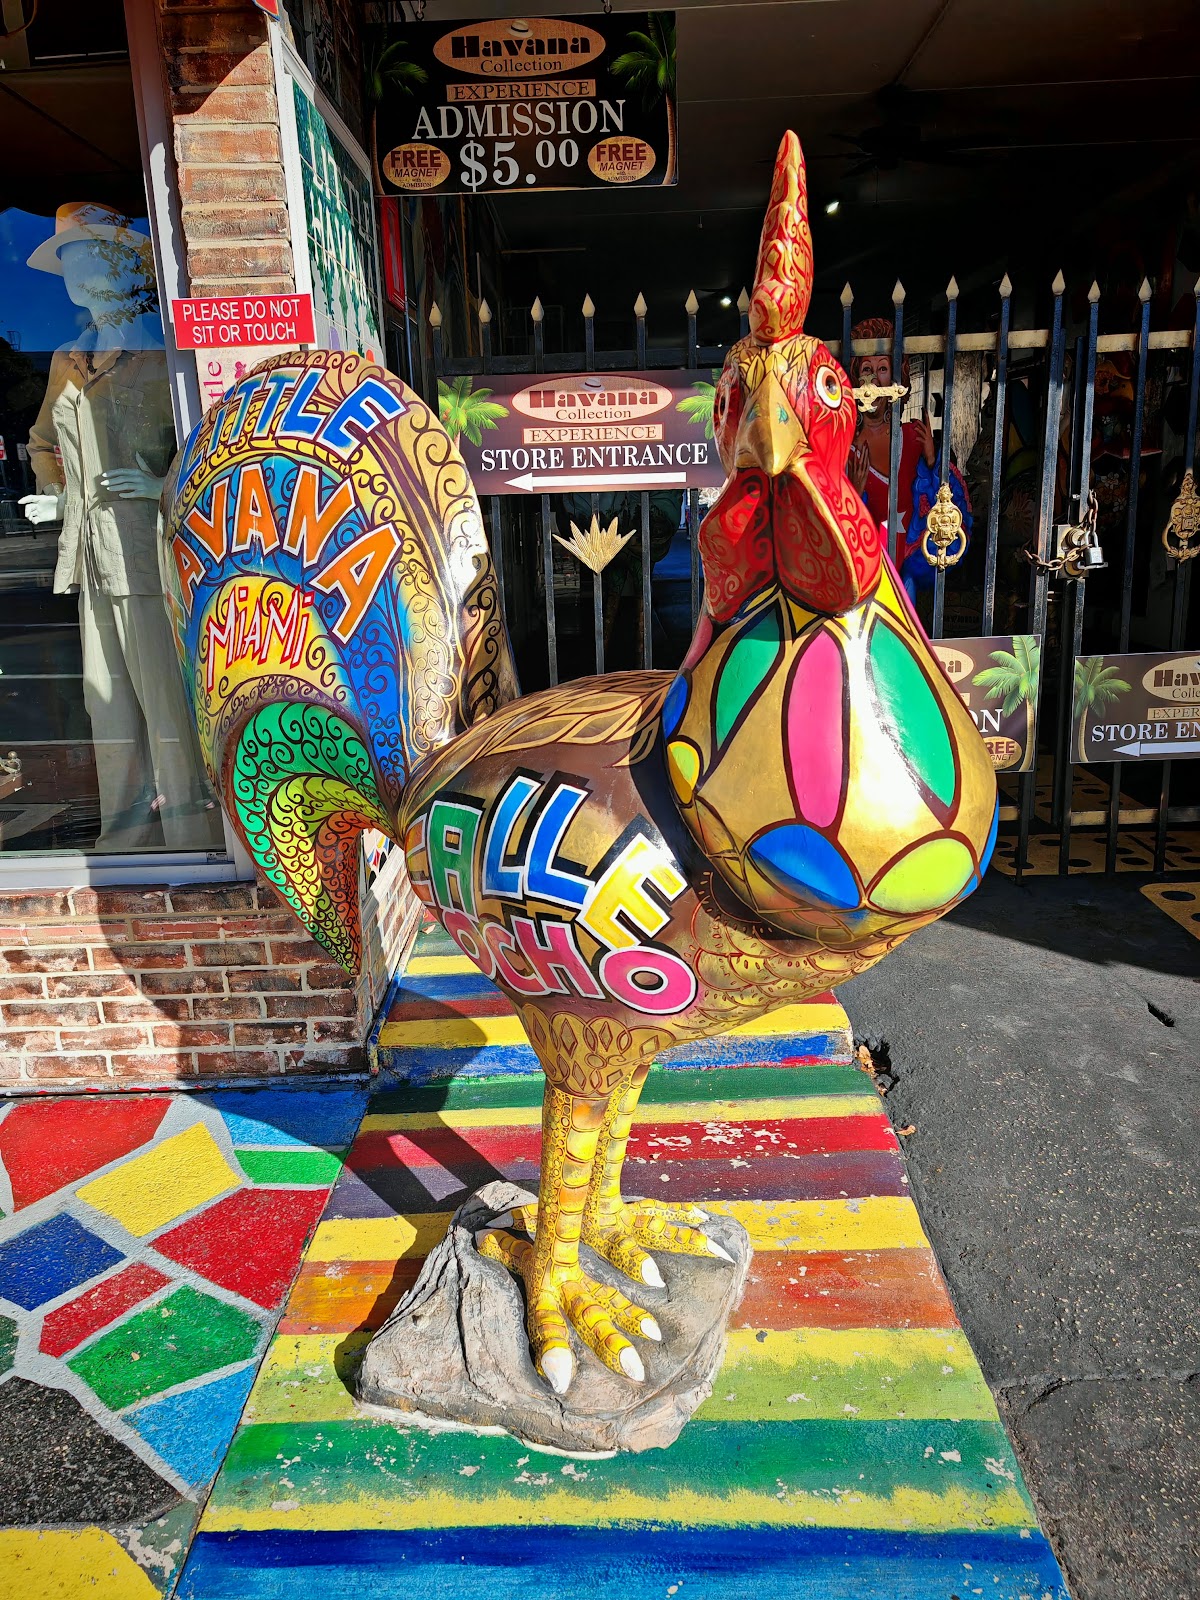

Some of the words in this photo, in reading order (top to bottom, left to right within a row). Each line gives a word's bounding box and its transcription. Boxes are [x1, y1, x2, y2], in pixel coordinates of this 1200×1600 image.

[451, 34, 591, 58] Havana
[480, 58, 563, 74] Collection
[453, 81, 591, 100] EXPERIENCE
[412, 100, 626, 140] ADMISSION
[390, 149, 442, 168] FREE
[596, 143, 647, 162] FREE
[394, 167, 440, 178] MAGNET
[599, 161, 645, 171] MAGNET
[182, 301, 241, 322] PLEASE
[243, 300, 266, 319] DO
[270, 299, 300, 318] NOT
[192, 325, 215, 344] SIT
[218, 324, 241, 343] OR
[243, 322, 297, 341] TOUCH
[529, 388, 658, 408] Havana
[555, 407, 632, 421] Collection
[529, 426, 657, 442] EXPERIENCE
[481, 448, 565, 471] STORE
[571, 443, 709, 469] ENTRANCE
[1091, 722, 1169, 742] STORE
[985, 741, 1016, 755] REE
[442, 911, 698, 1015] OCHO
